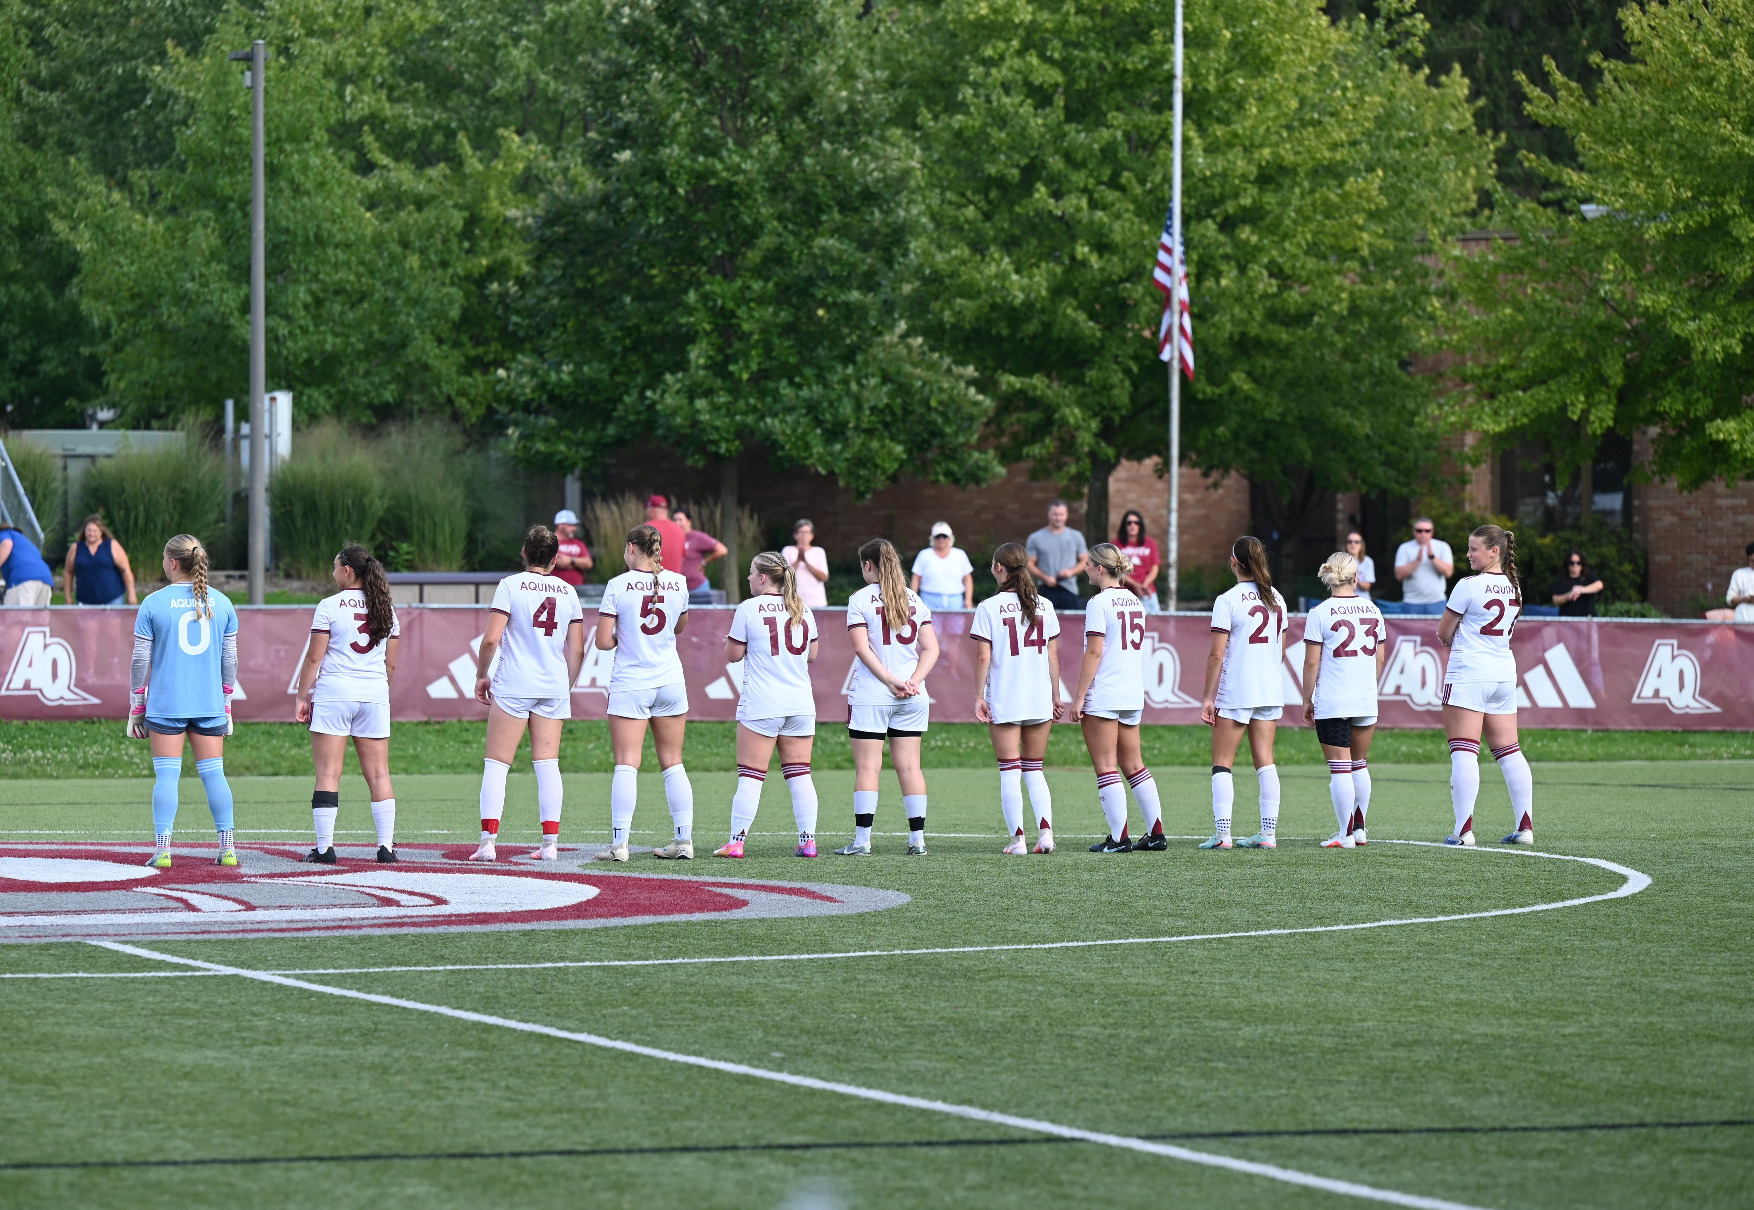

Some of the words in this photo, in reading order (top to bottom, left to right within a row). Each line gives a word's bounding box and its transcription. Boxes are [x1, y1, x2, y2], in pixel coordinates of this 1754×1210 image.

[520, 581, 569, 595] AQUINAS
[626, 581, 680, 592] AQUNAS
[1485, 584, 1515, 594] AQUIN
[532, 596, 558, 637] 4
[640, 595, 666, 635] 5
[1116, 610, 1145, 651] 15
[1330, 605, 1377, 616] AQUINAS
[1479, 598, 1521, 636] 27
[178, 610, 211, 655] 0
[349, 612, 377, 654] 3
[762, 616, 809, 656] 10
[1002, 615, 1047, 656] 14
[1329, 617, 1380, 658] 23
[1, 627, 101, 706] AQ
[1377, 635, 1443, 711] AQ
[1632, 639, 1722, 714] AQ
